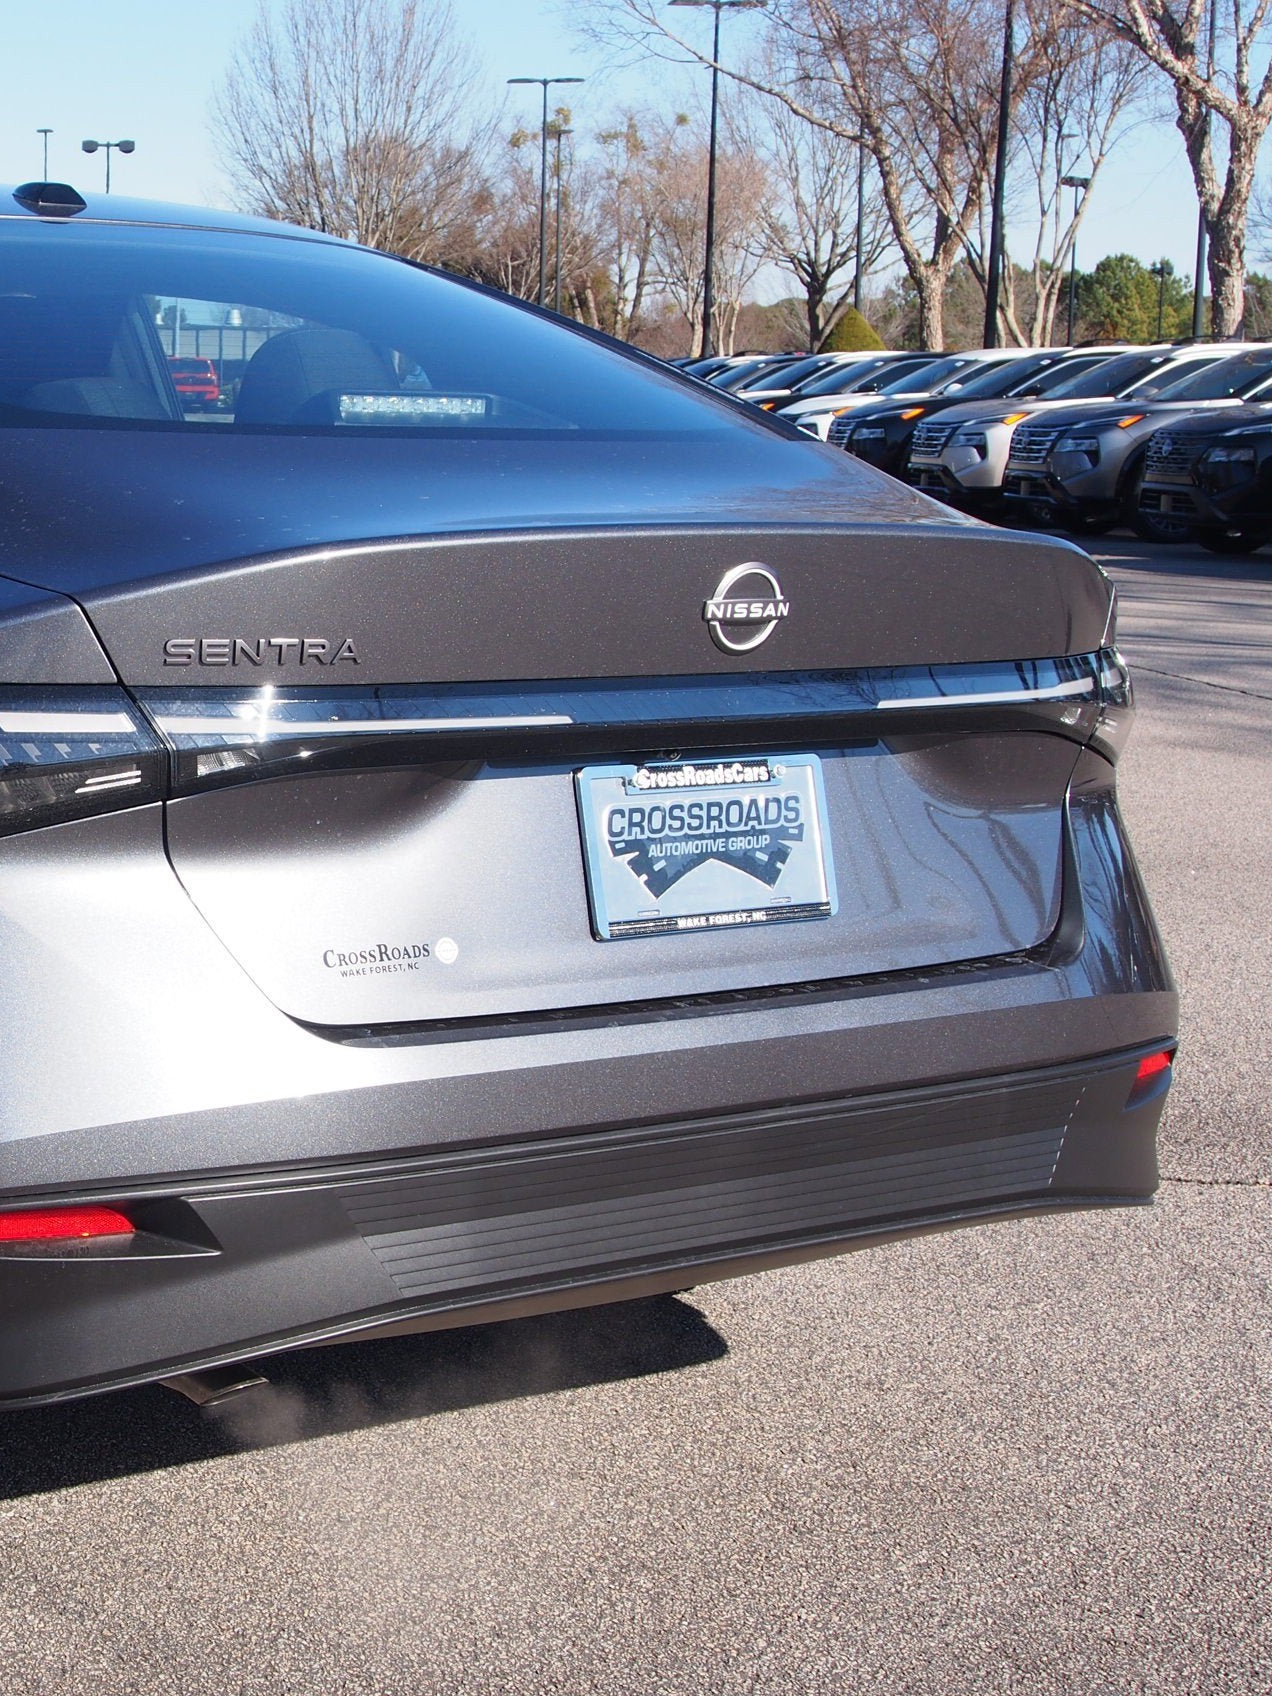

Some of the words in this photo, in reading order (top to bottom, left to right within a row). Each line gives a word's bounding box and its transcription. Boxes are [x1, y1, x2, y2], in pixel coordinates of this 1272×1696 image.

[707, 602, 789, 618] NISSAN
[163, 638, 361, 667] SENTRA
[636, 763, 769, 788] CrossRoadsCars
[607, 795, 801, 839] CROSSROADS
[648, 838, 726, 858] AUTOMOTIVE
[729, 834, 770, 851] GROUP
[677, 916, 707, 928] WAKE
[752, 911, 767, 921] NC
[340, 966, 367, 978] WAKE
[369, 963, 406, 974] FOREST,
[407, 961, 420, 971] NC
